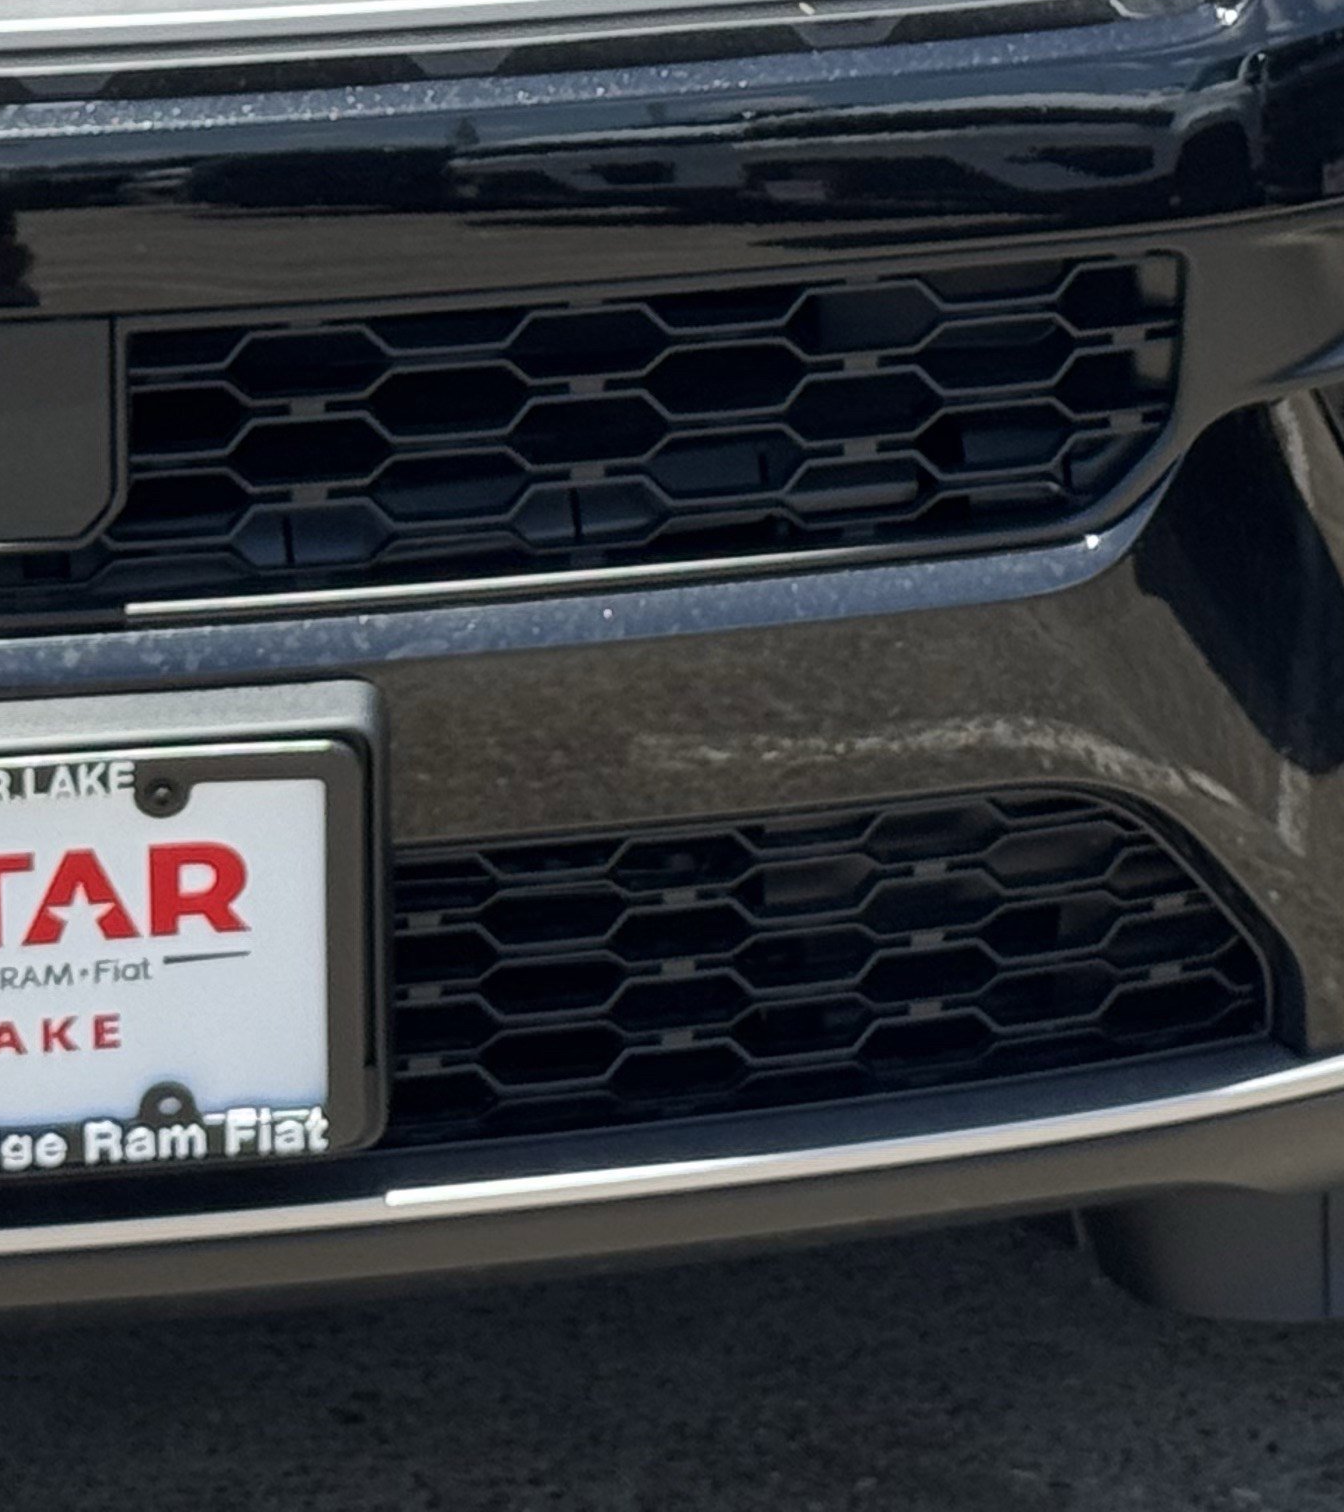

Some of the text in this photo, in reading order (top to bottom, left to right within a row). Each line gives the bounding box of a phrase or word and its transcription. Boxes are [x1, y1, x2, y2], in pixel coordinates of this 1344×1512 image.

[25, 760, 136, 799] LAKE
[0, 962, 74, 990] RAM
[92, 957, 153, 984] Fiat
[83, 1118, 208, 1165] Ram
[224, 1105, 330, 1158] Fiat
